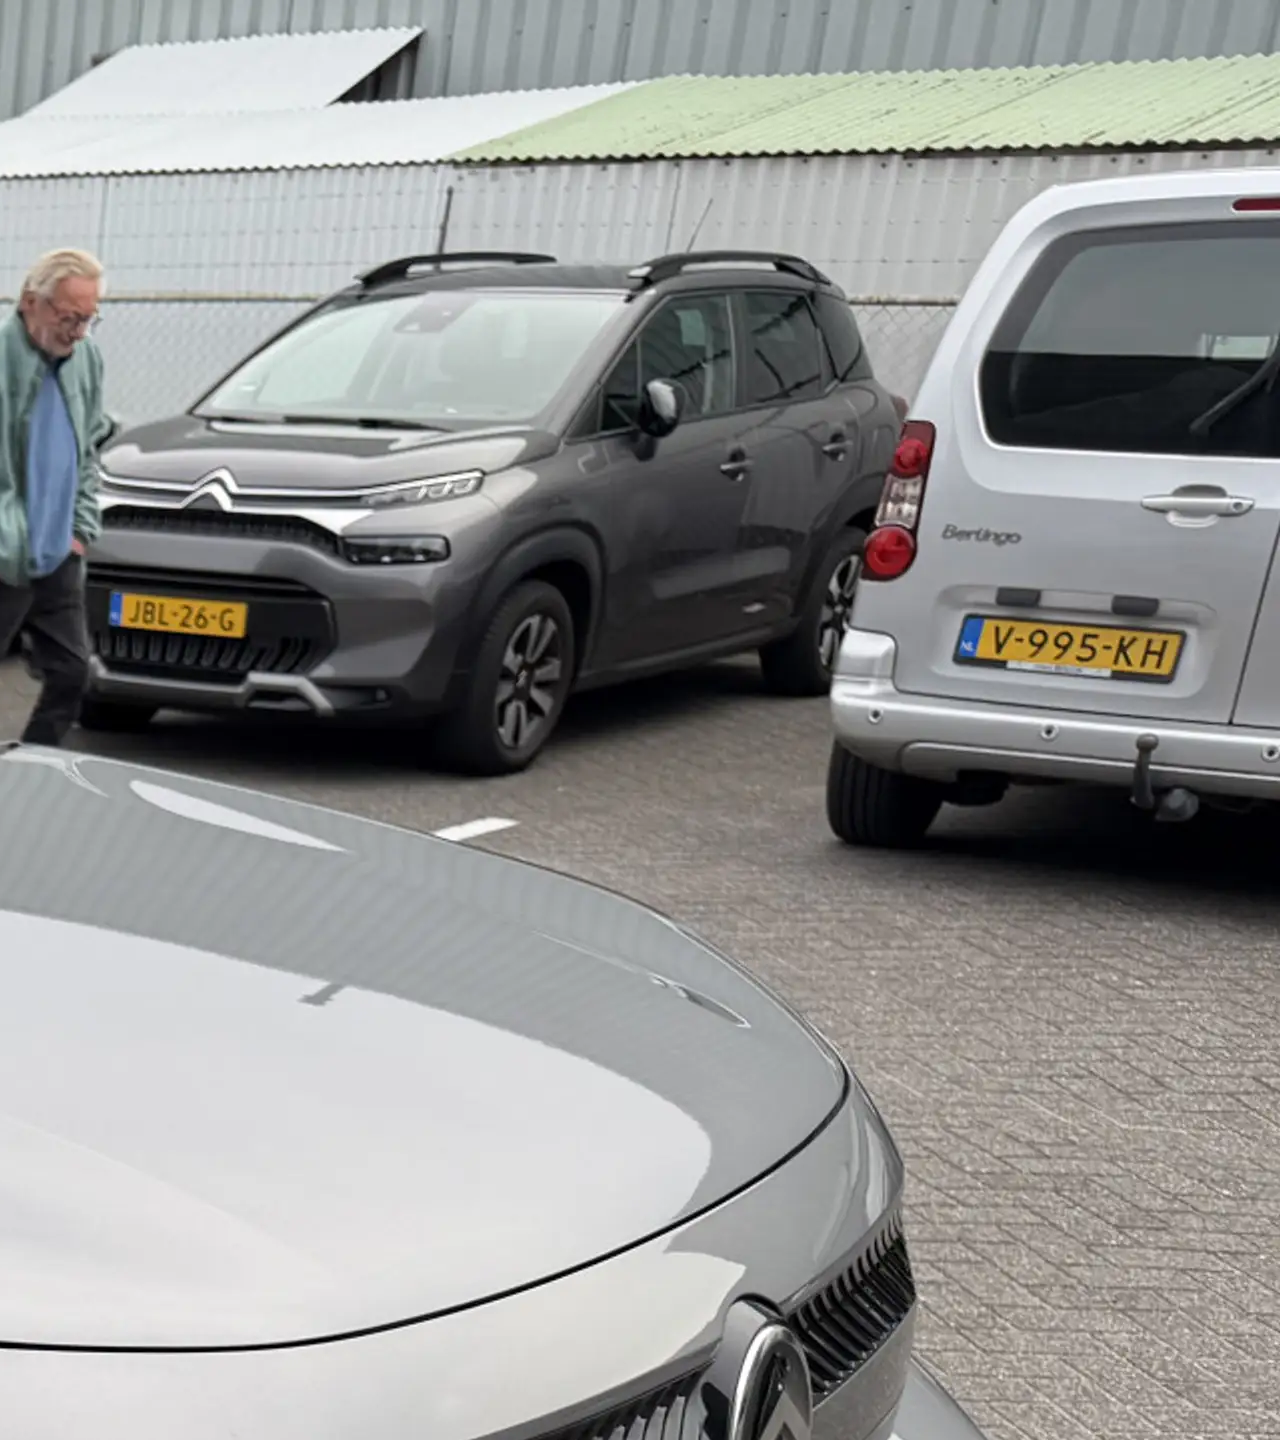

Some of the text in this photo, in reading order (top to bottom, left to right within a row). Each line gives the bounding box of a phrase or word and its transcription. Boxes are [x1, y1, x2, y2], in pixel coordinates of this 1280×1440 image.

[942, 523, 1022, 548] Berlingo
[128, 600, 235, 632] JBL-26-G
[993, 625, 1169, 670] V-995-KH
